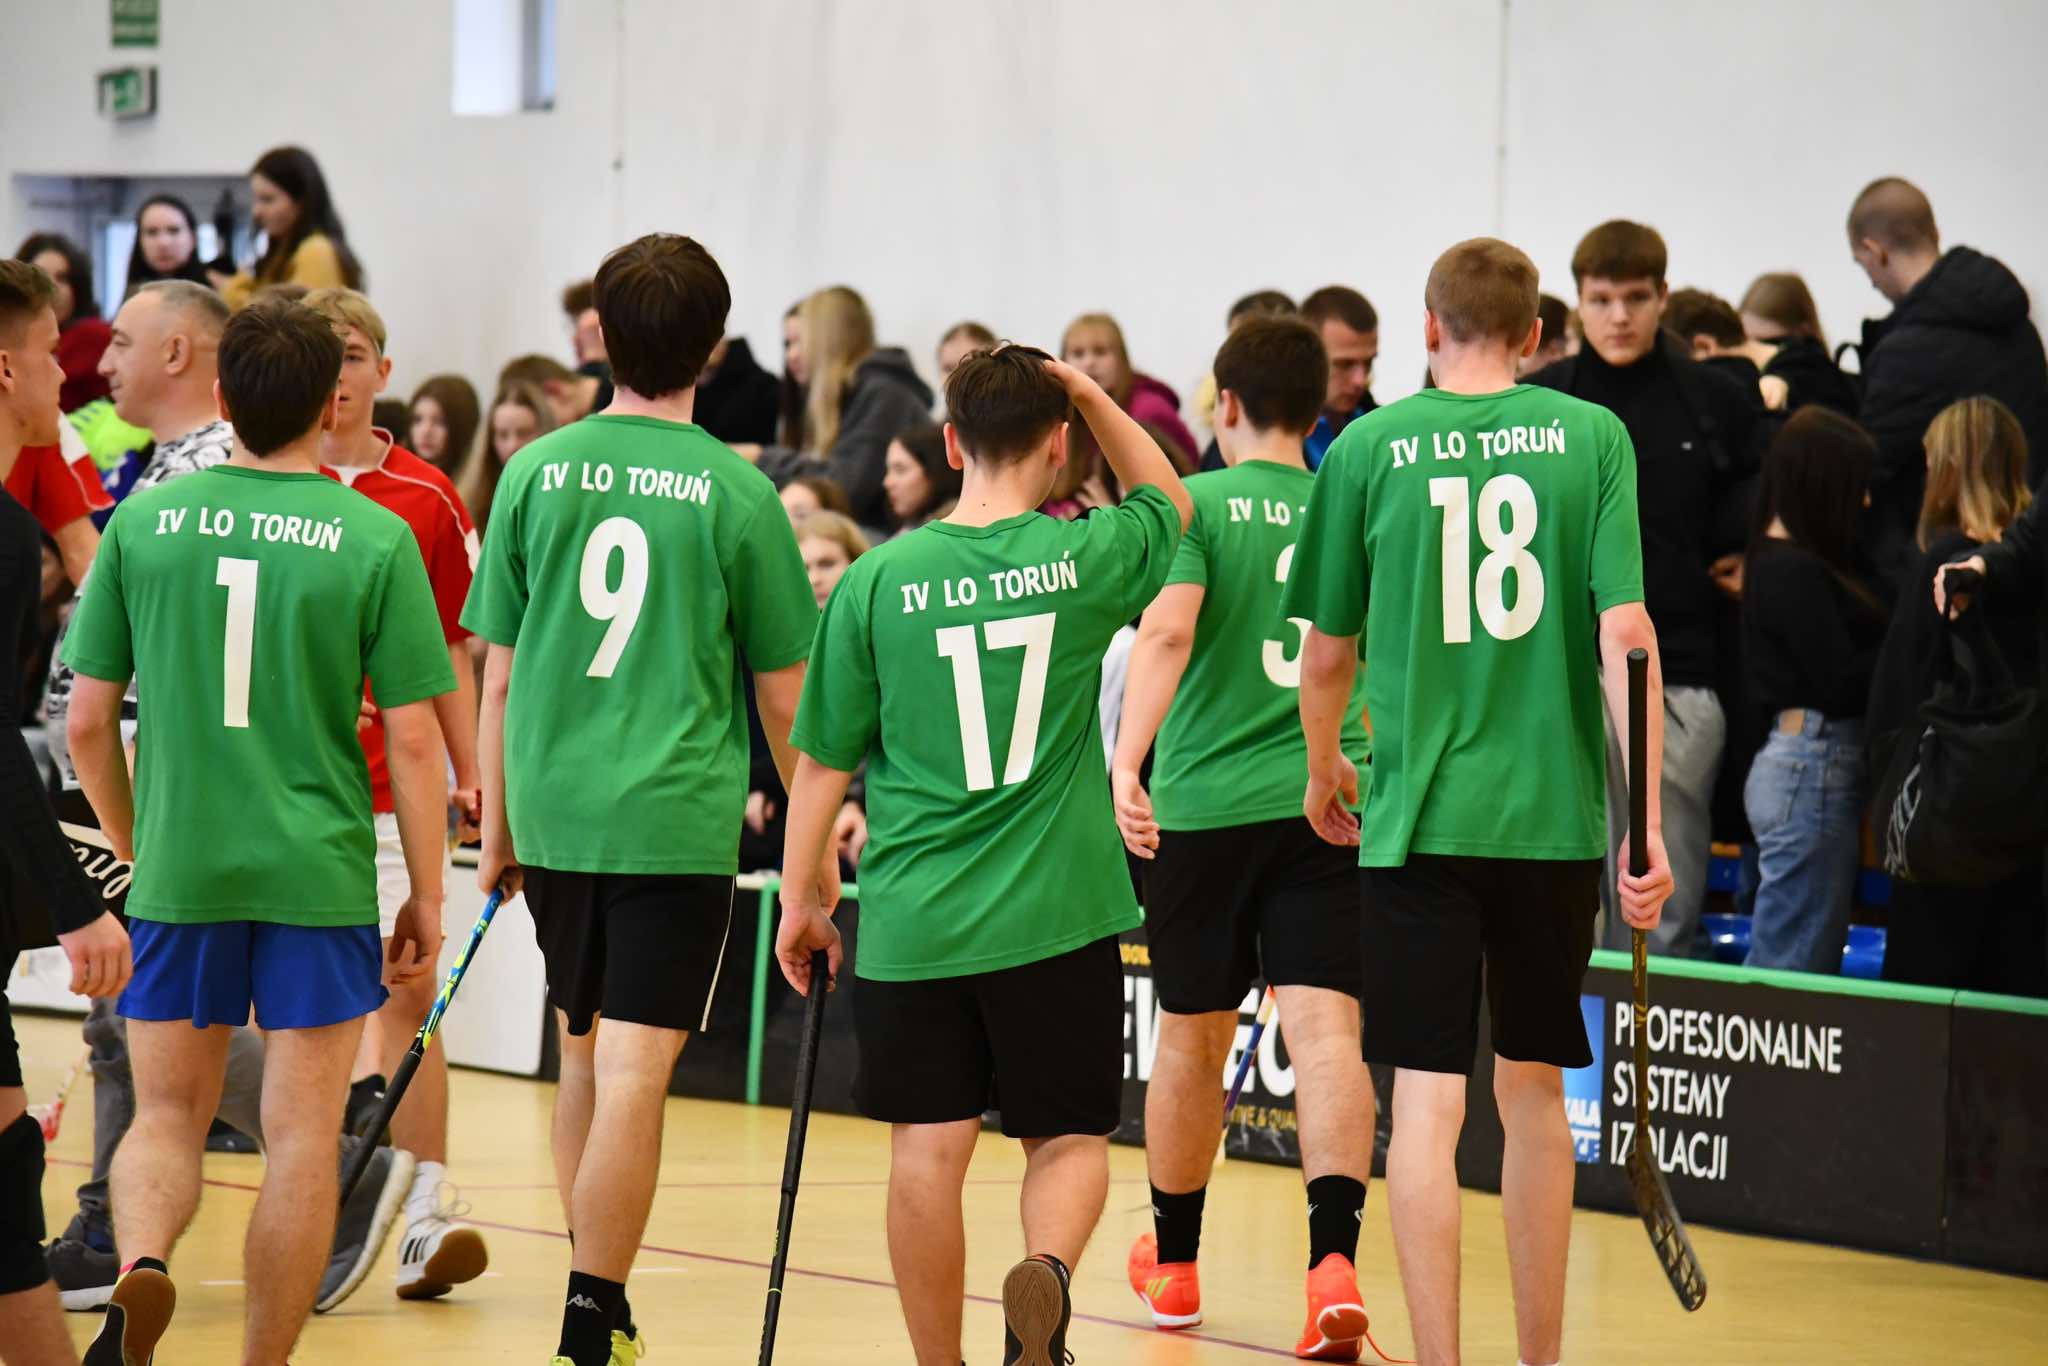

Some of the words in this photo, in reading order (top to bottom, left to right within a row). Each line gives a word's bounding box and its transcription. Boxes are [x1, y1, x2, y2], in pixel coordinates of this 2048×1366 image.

[1389, 436, 1419, 469] IV
[1432, 430, 1466, 460] LO
[1476, 418, 1566, 460] TORUŃ
[541, 461, 570, 492] IV
[581, 462, 614, 492] LO
[626, 466, 712, 506] TORUŃ
[1227, 497, 1253, 522] IV
[1263, 498, 1291, 526] LO
[155, 507, 188, 535] IV
[198, 506, 235, 537] LO
[249, 511, 343, 553] TORUŃ
[1428, 473, 1546, 644] 18
[579, 516, 649, 678] 9
[900, 581, 930, 614] IV
[943, 576, 978, 608] LO
[988, 550, 1078, 601] TORUŃ
[215, 556, 259, 728] 1
[935, 612, 1057, 792] 17
